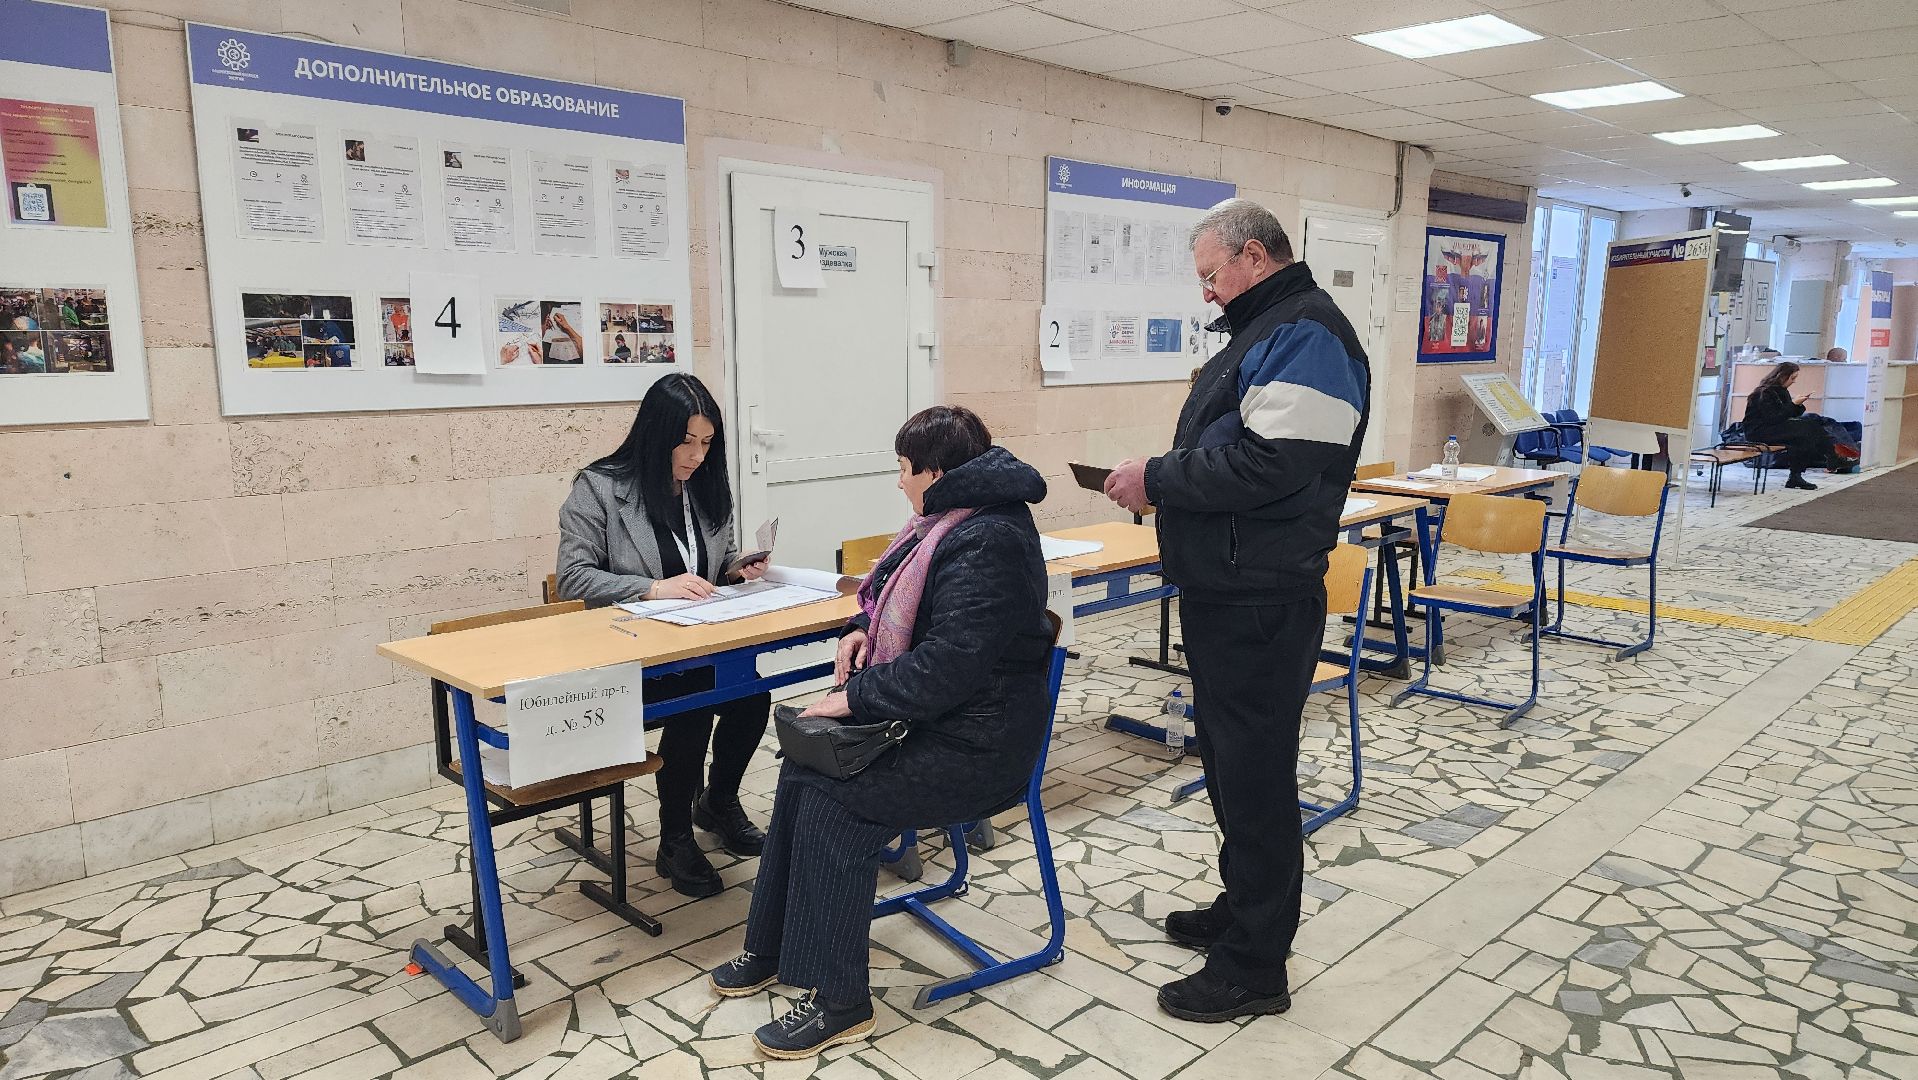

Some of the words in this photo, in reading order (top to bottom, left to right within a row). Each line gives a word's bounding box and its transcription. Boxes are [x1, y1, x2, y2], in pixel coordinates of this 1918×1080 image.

[294, 57, 491, 101] ДОПОЛНИТЕЛЬНОЕ
[496, 87, 620, 119] ОБРАЗОВАНИЕ
[1121, 177, 1177, 196] ИНФОРМАЦИЯ
[790, 224, 806, 260] 3
[818, 247, 848, 258] Мужская
[1648, 248, 1671, 258] УЧАСТОК
[434, 295, 462, 339] 4
[1049, 320, 1061, 349] 2
[519, 687, 598, 711] Юбилейный
[601, 685, 629, 698] пр-т,
[546, 726, 557, 737] д.
[562, 718, 578, 733] №
[582, 707, 605, 729] 58
